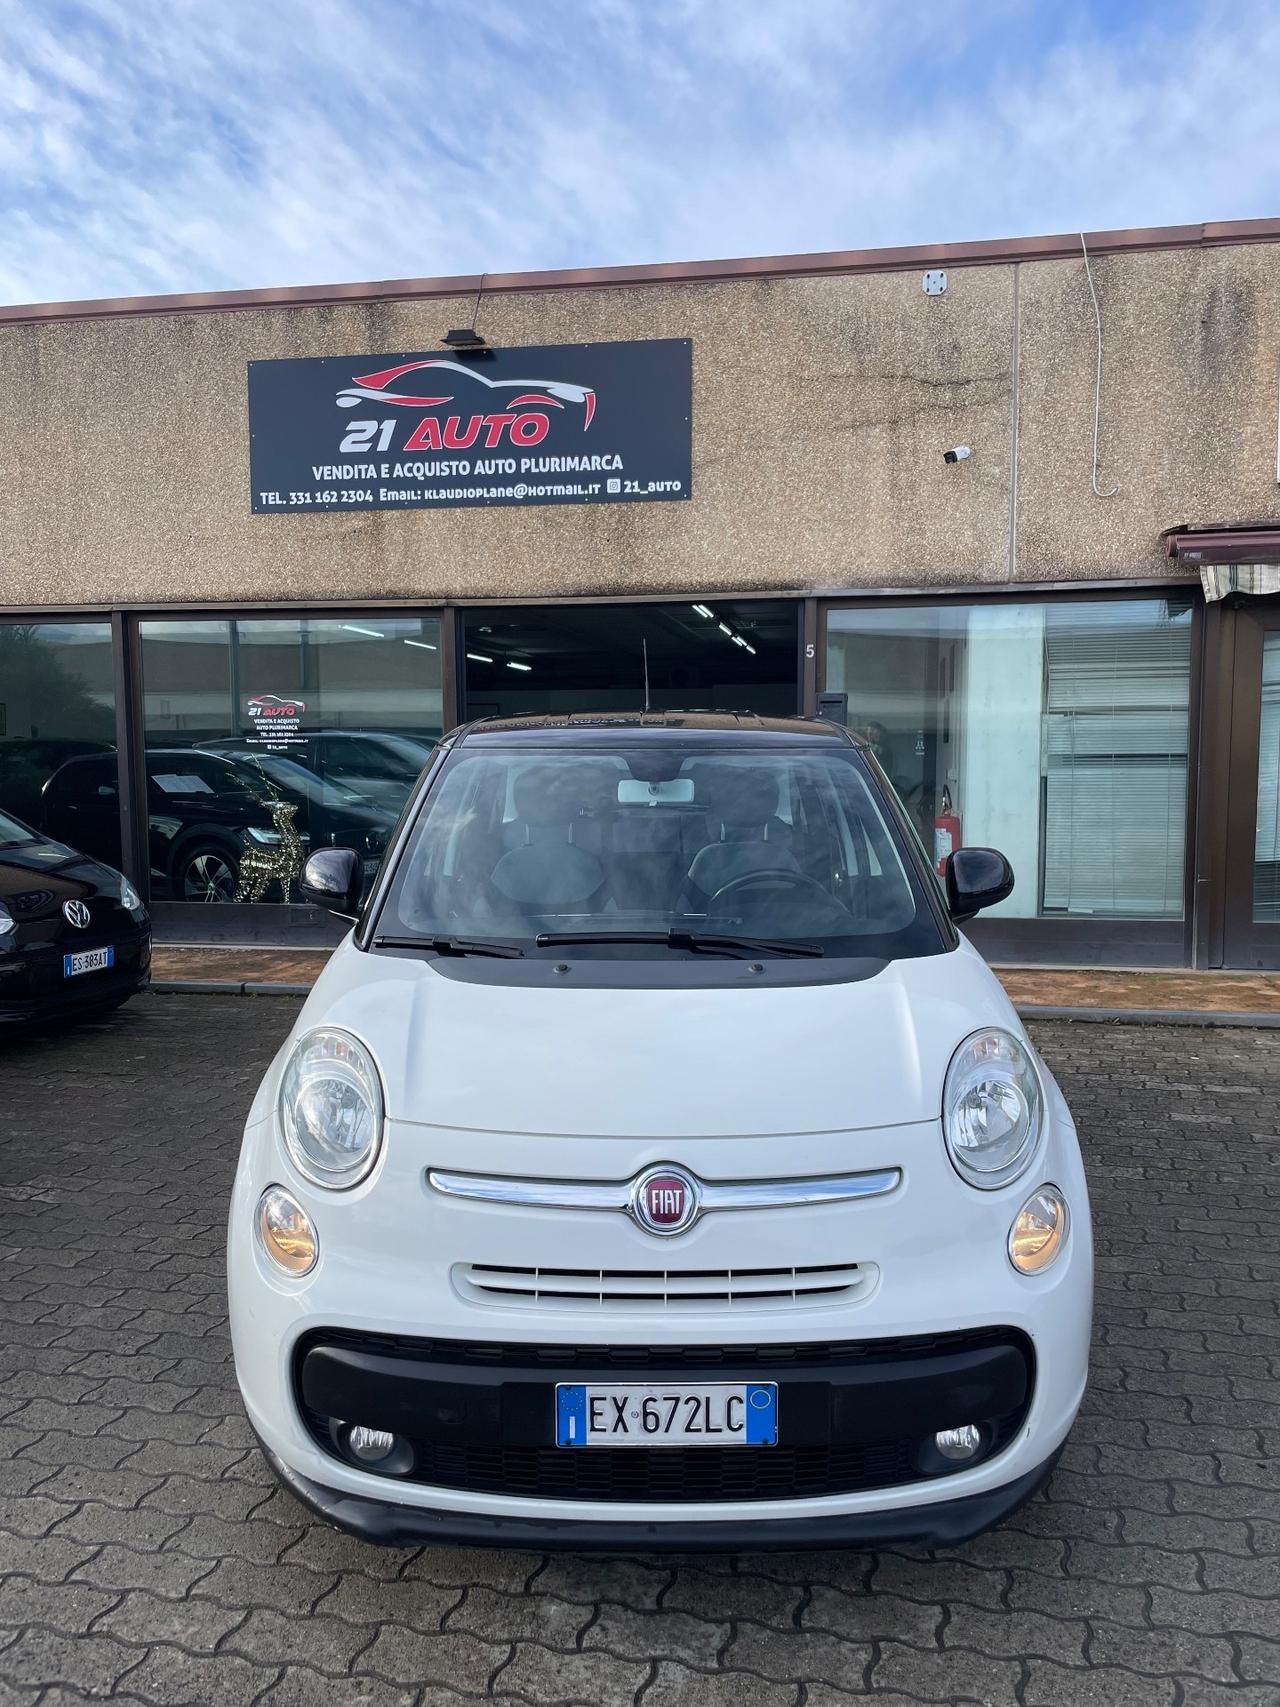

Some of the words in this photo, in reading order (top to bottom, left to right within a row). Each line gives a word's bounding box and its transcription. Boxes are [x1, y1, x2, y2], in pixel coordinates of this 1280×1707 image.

[339, 419, 397, 453] 21
[402, 412, 550, 451] AUTO
[312, 464, 377, 480] VENDITA
[381, 463, 390, 478] E
[393, 460, 470, 480] ACQUISTO
[474, 458, 516, 475] AUTO
[520, 454, 624, 473] PLURIMARCA
[260, 492, 287, 505] TEL.
[289, 492, 312, 505] 331
[315, 490, 338, 503] 162
[340, 489, 373, 503] 2304
[806, 644, 815, 658] 5
[248, 707, 262, 716] 21
[263, 707, 295, 716] AUTO
[652, 1189, 682, 1214] FIAT
